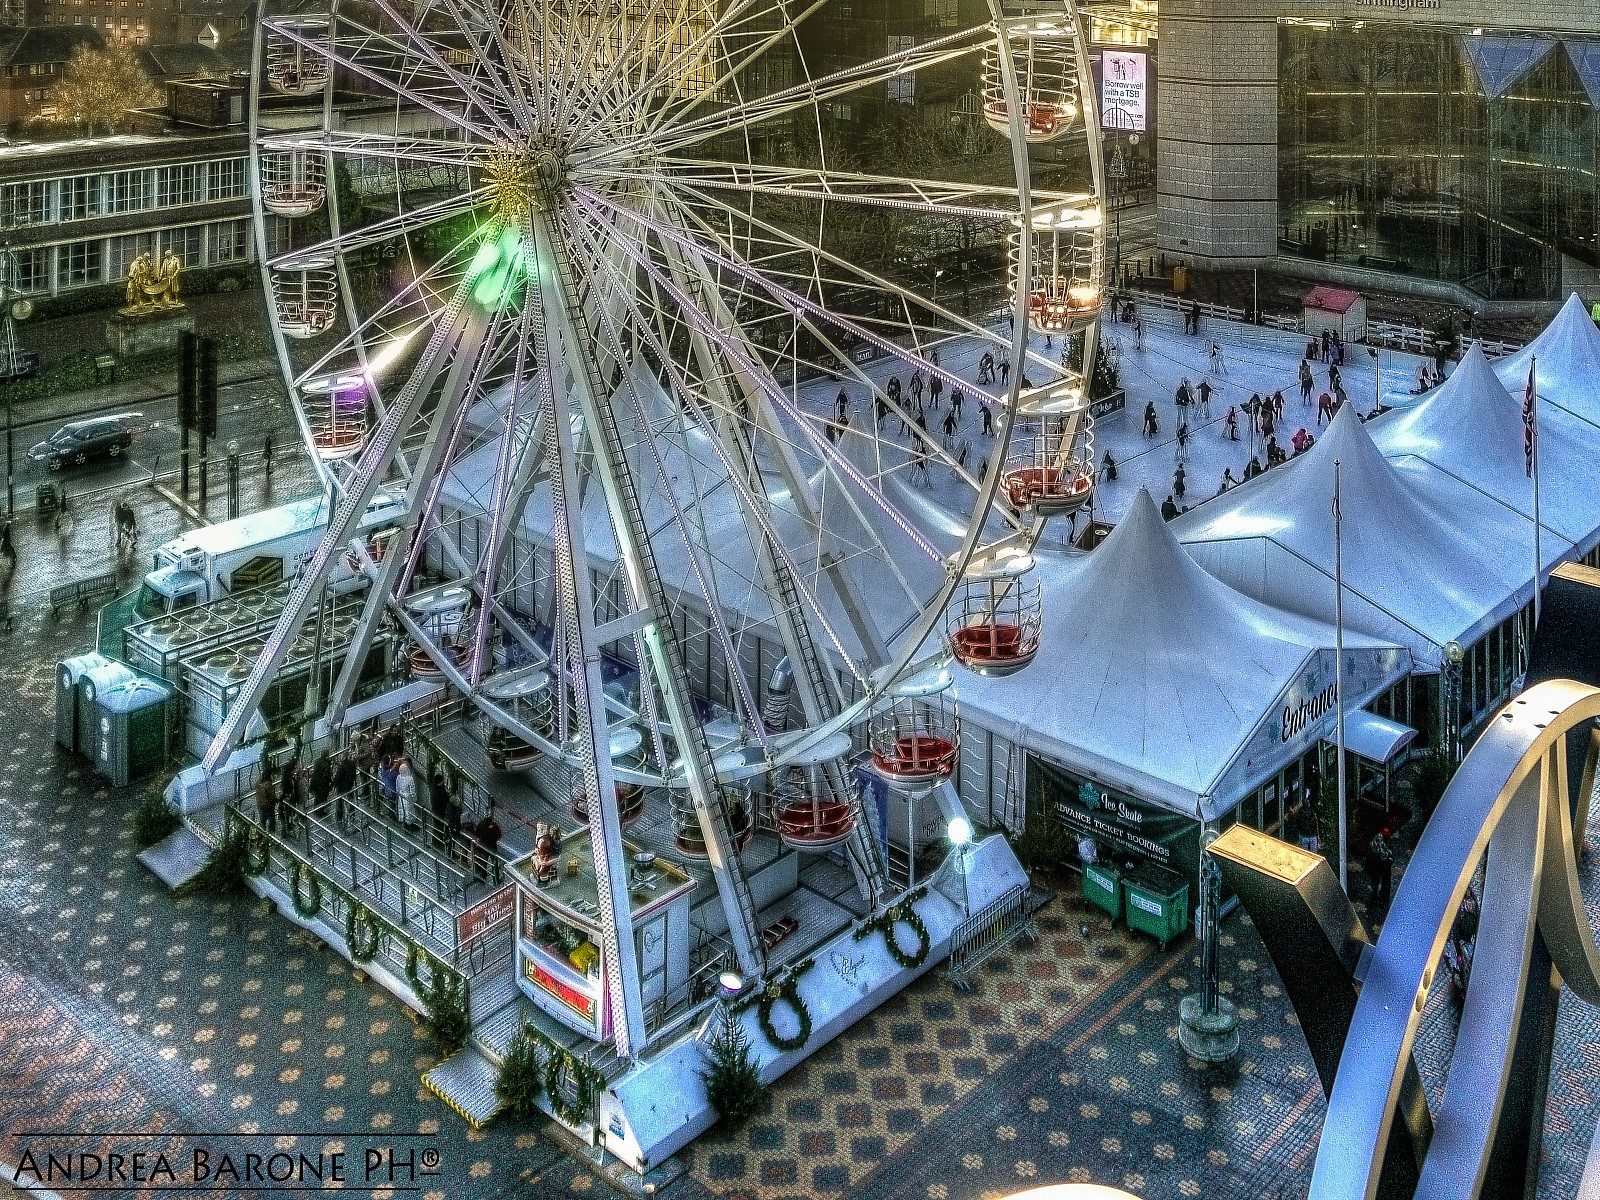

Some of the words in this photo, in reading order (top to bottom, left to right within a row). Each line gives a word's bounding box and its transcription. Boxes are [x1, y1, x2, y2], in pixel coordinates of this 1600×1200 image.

[1104, 80, 1130, 89] Borrow
[1130, 82, 1144, 90] well
[1104, 87, 1119, 96] with
[1125, 89, 1140, 98] TSB
[1101, 793, 1117, 812] Ice
[1117, 802, 1143, 824] Skate
[1054, 801, 1091, 825] ADVANCE
[1093, 818, 1124, 838] TICKET
[1126, 832, 1170, 858] BOOKINGS
